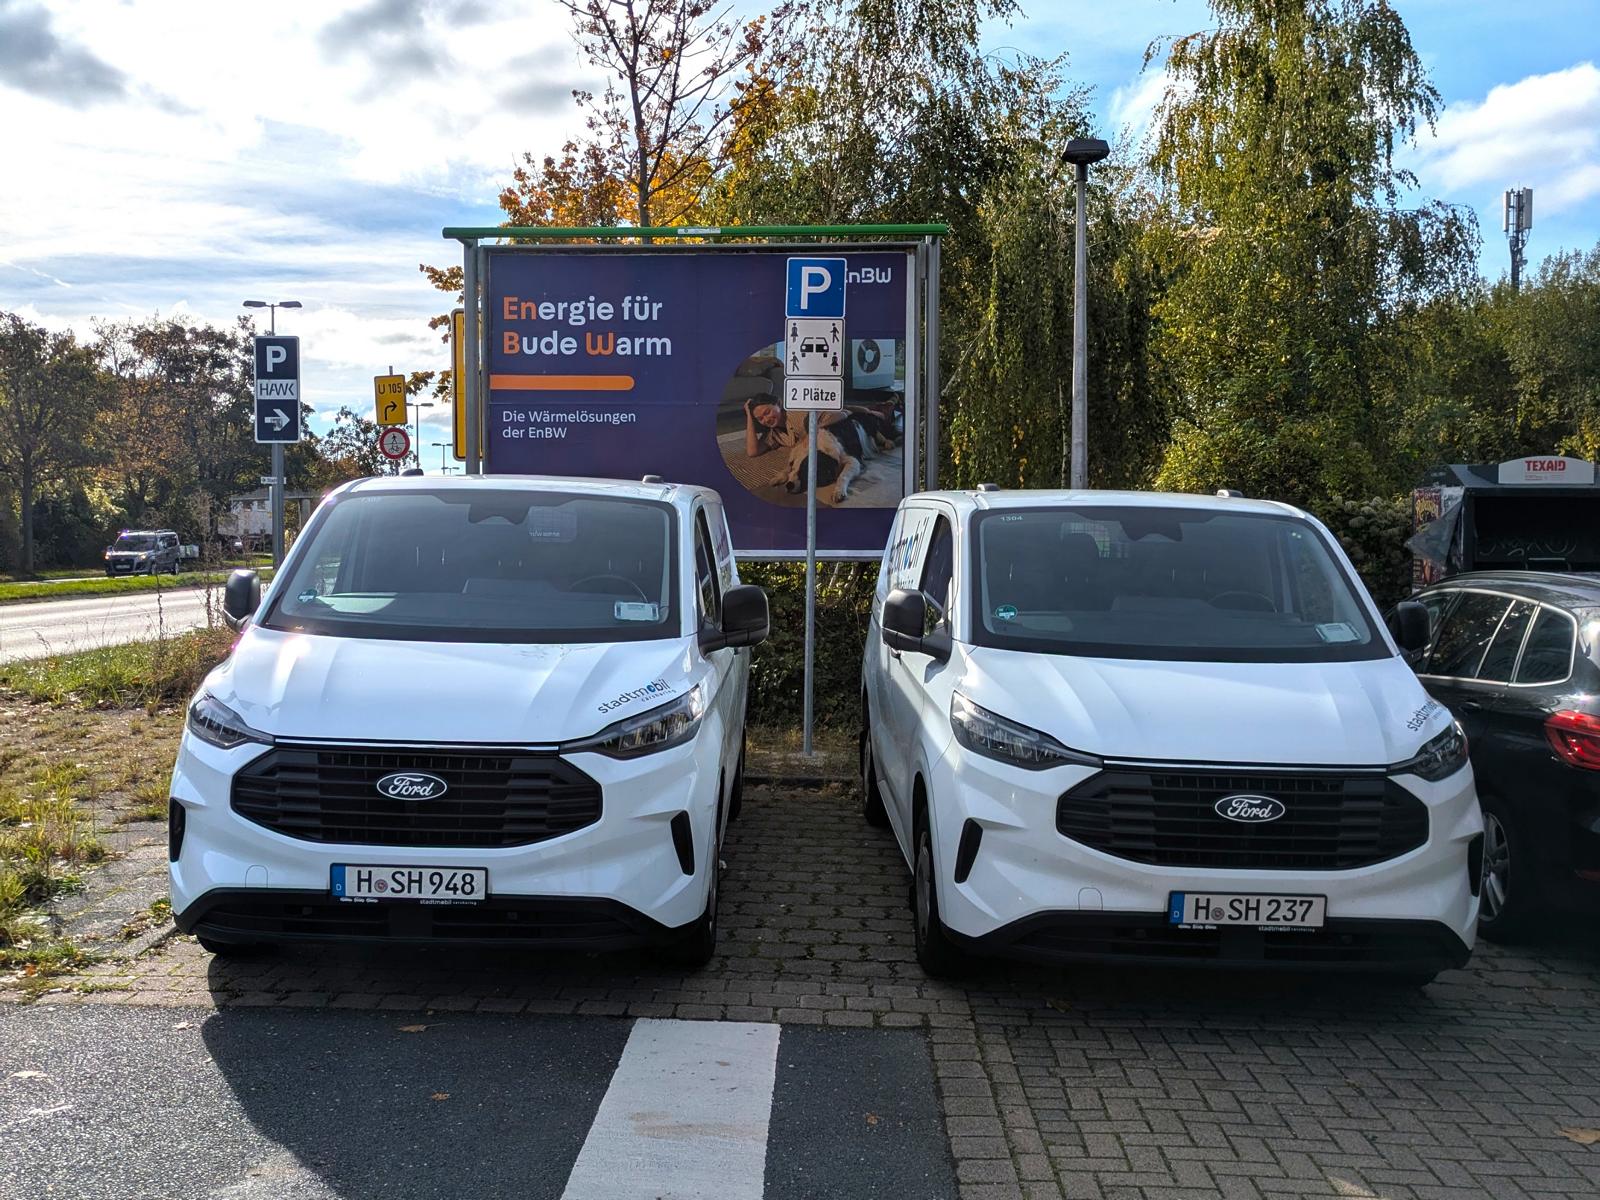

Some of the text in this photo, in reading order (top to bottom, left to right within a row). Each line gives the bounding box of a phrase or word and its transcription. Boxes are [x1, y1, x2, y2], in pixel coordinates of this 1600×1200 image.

[800, 266, 832, 310] P
[503, 295, 663, 326] Energie für
[503, 330, 673, 356] Bude Warm
[266, 345, 287, 373] P
[259, 382, 295, 396] HAWK
[377, 382, 402, 395] U 105
[791, 387, 837, 402] 2 Plätze
[502, 410, 637, 425] Die Wärmelösungen
[502, 426, 568, 439] der EnBW
[1524, 460, 1567, 472] TEXAID
[598, 678, 671, 714] stadtmobil
[388, 776, 435, 796] Ford
[1227, 798, 1273, 818] Ford
[335, 883, 342, 891] D
[357, 869, 372, 893] H
[1173, 910, 1180, 918] D
[1194, 897, 1210, 920] H
